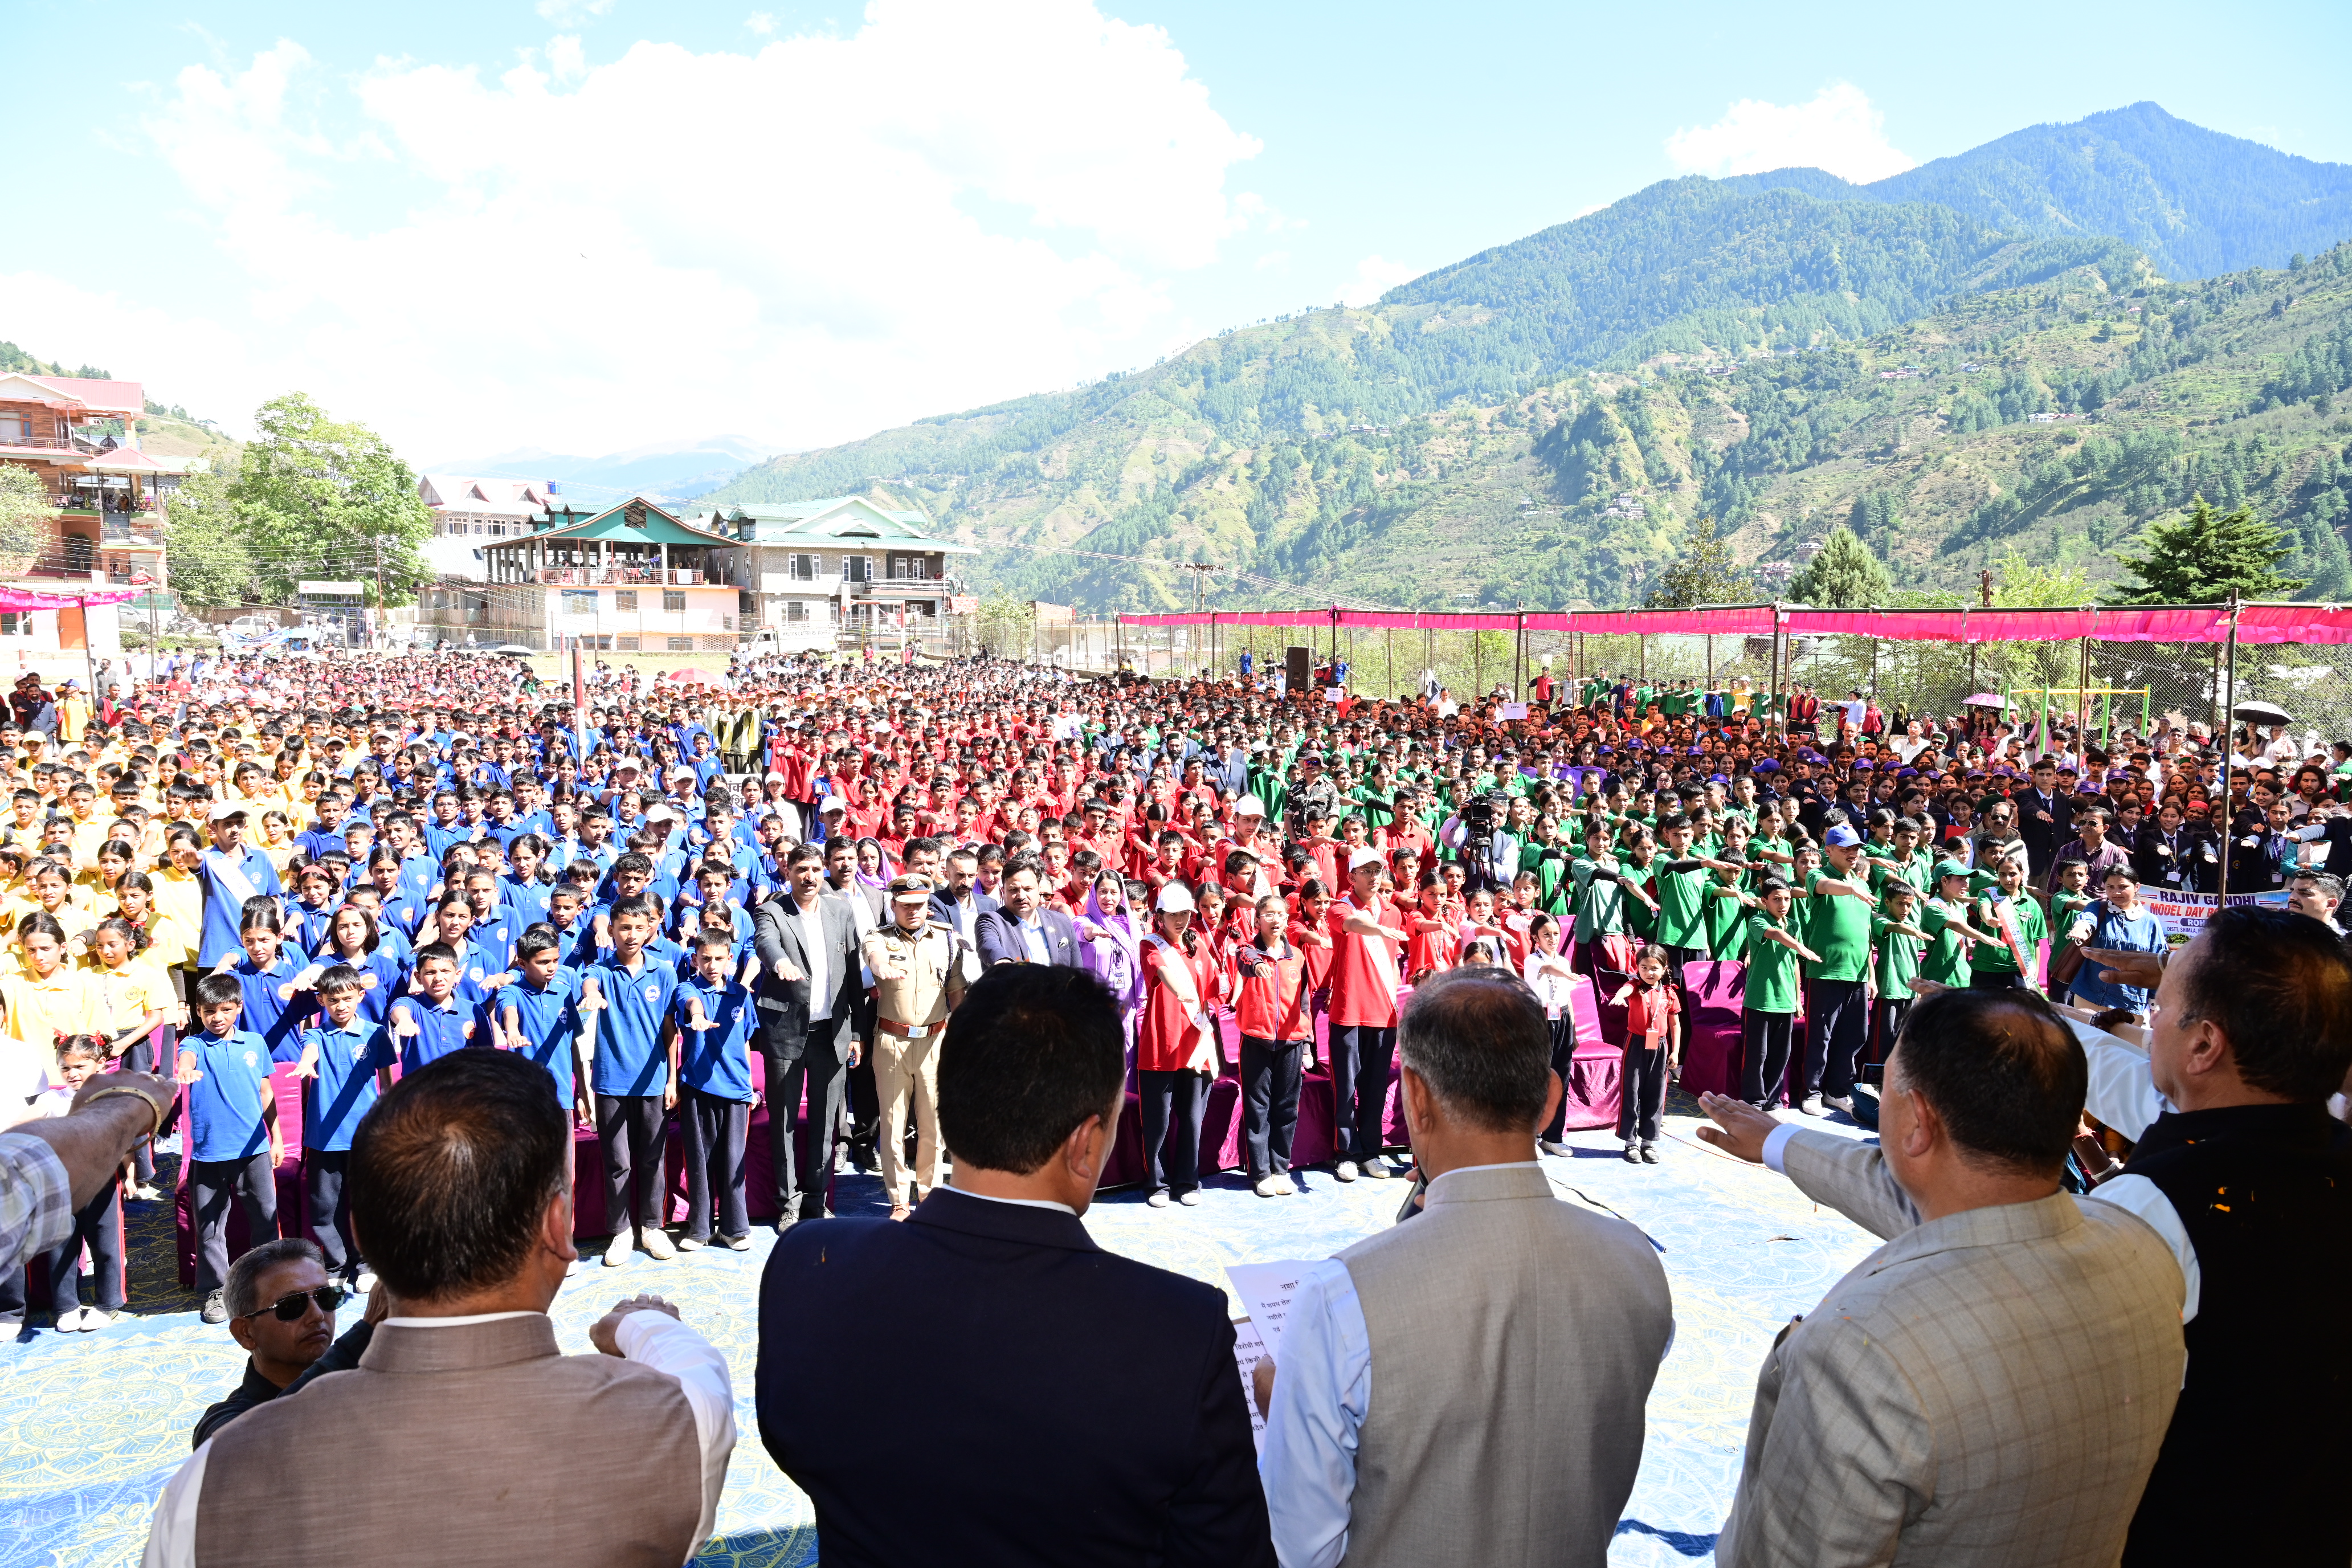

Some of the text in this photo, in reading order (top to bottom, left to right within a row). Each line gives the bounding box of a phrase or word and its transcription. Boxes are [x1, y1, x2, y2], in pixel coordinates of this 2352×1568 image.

[2160, 891, 2199, 904] RAJIV
[2150, 903, 2182, 916] MODEL
[2185, 906, 2205, 917] DAY
[2012, 922, 2032, 962] COMMANDER
[1235, 1341, 1253, 1350] विरोधी
